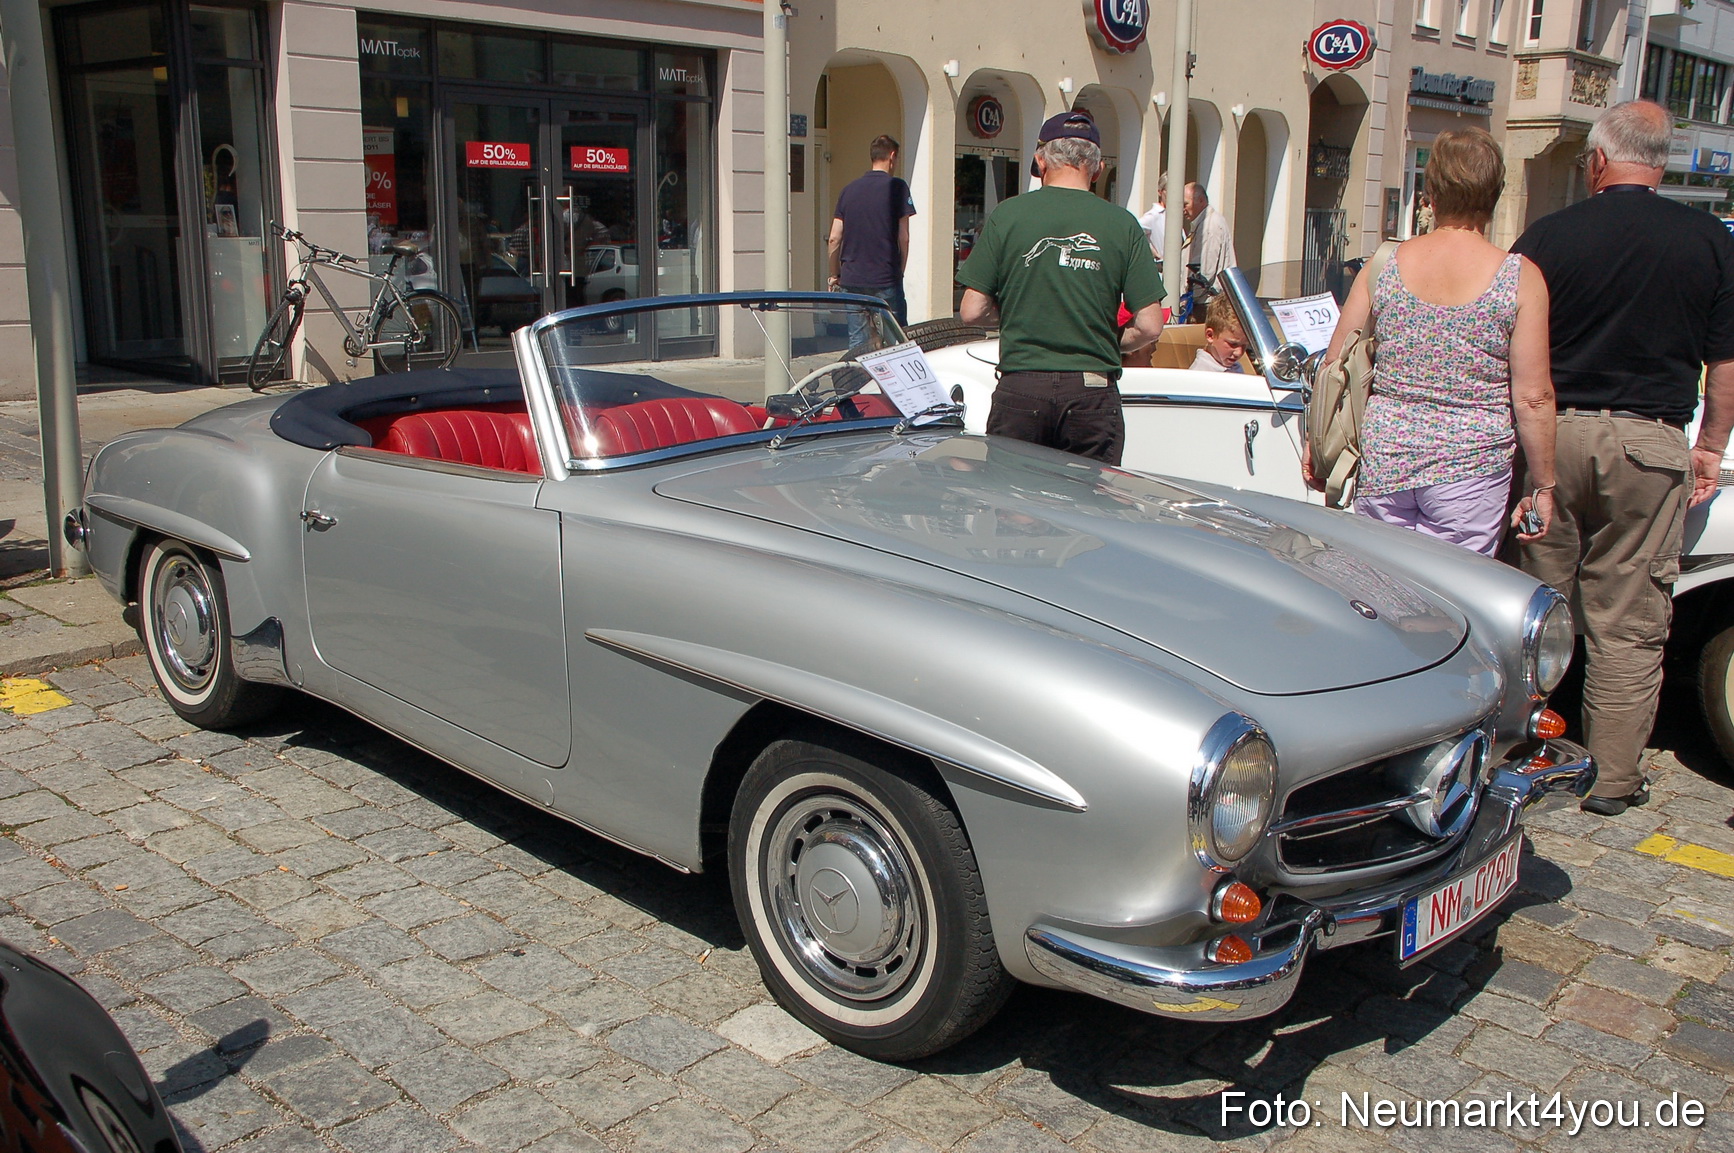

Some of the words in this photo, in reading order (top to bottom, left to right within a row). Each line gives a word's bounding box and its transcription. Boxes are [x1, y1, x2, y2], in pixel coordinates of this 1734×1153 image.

[1110, 0, 1143, 28] C&A
[1319, 32, 1357, 55] C&A
[981, 107, 1000, 126] C&A
[483, 144, 516, 160] 50%
[586, 148, 616, 164] 50%
[1059, 246, 1101, 271] Express
[1304, 307, 1332, 326] 329
[900, 359, 927, 382] 119
[1429, 879, 1463, 937] NM
[1406, 933, 1413, 947] D
